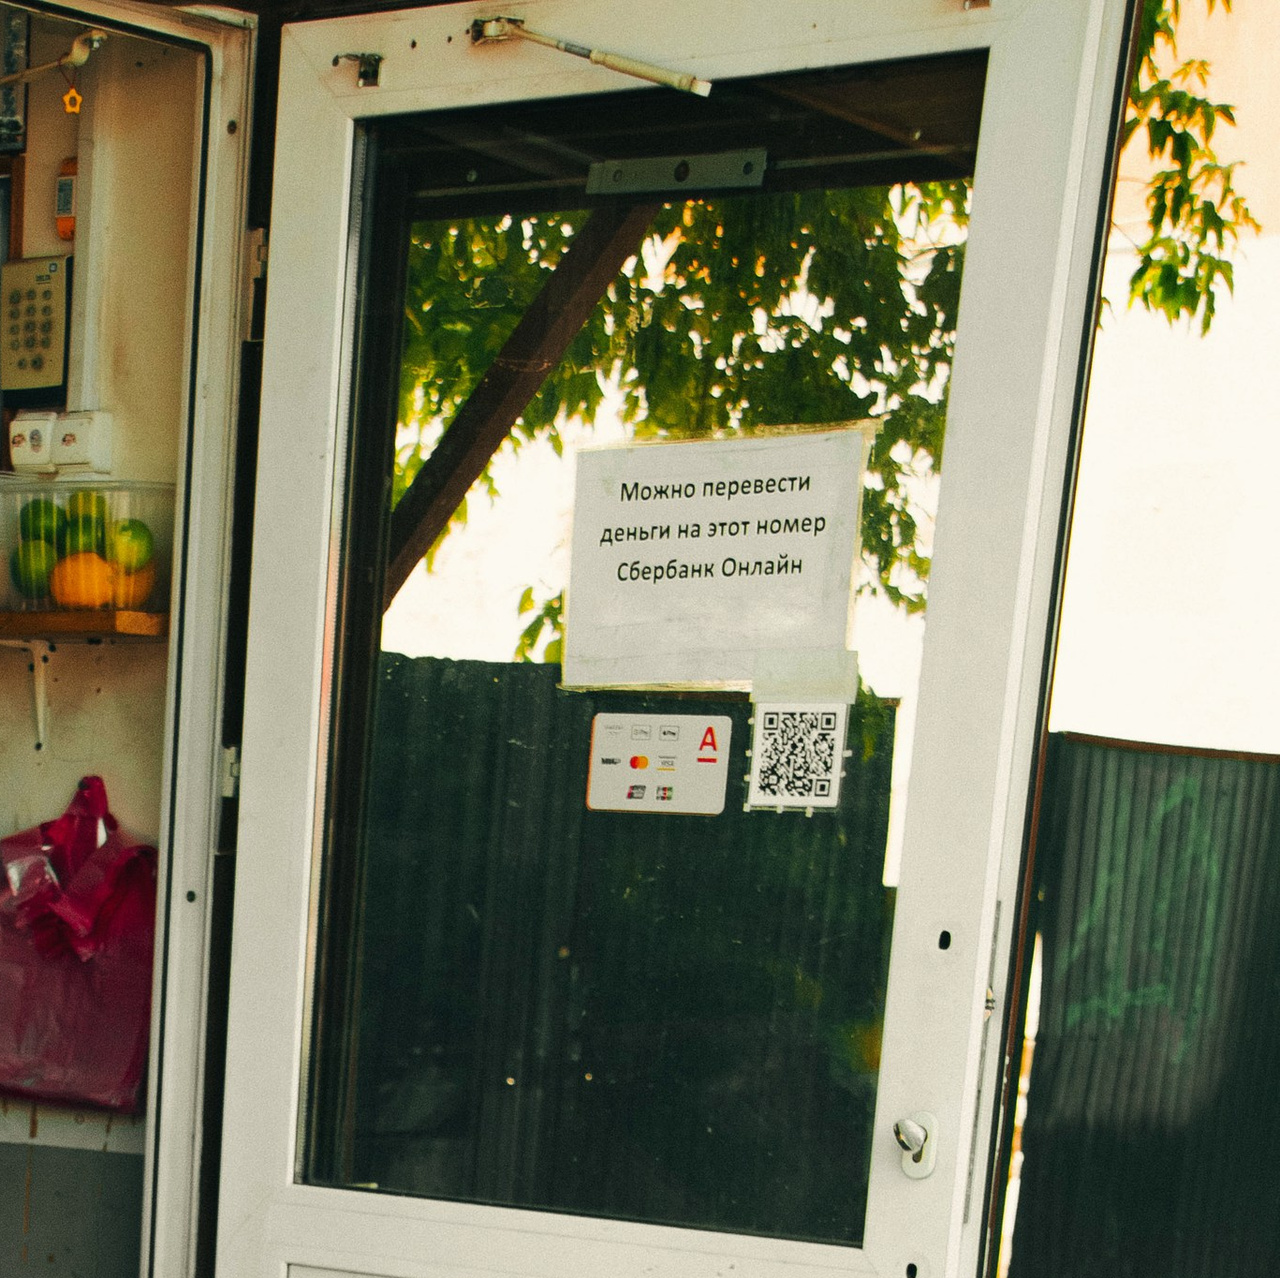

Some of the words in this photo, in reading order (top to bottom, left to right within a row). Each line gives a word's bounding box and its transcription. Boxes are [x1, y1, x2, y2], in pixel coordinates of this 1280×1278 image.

[620, 481, 696, 502] Можно
[702, 475, 811, 501] перевести
[599, 524, 671, 547] деньги
[677, 523, 701, 539] на
[707, 520, 751, 538] этот
[756, 516, 826, 538] номер
[617, 558, 715, 584] Сбербанк
[721, 553, 803, 578] Онлайн
